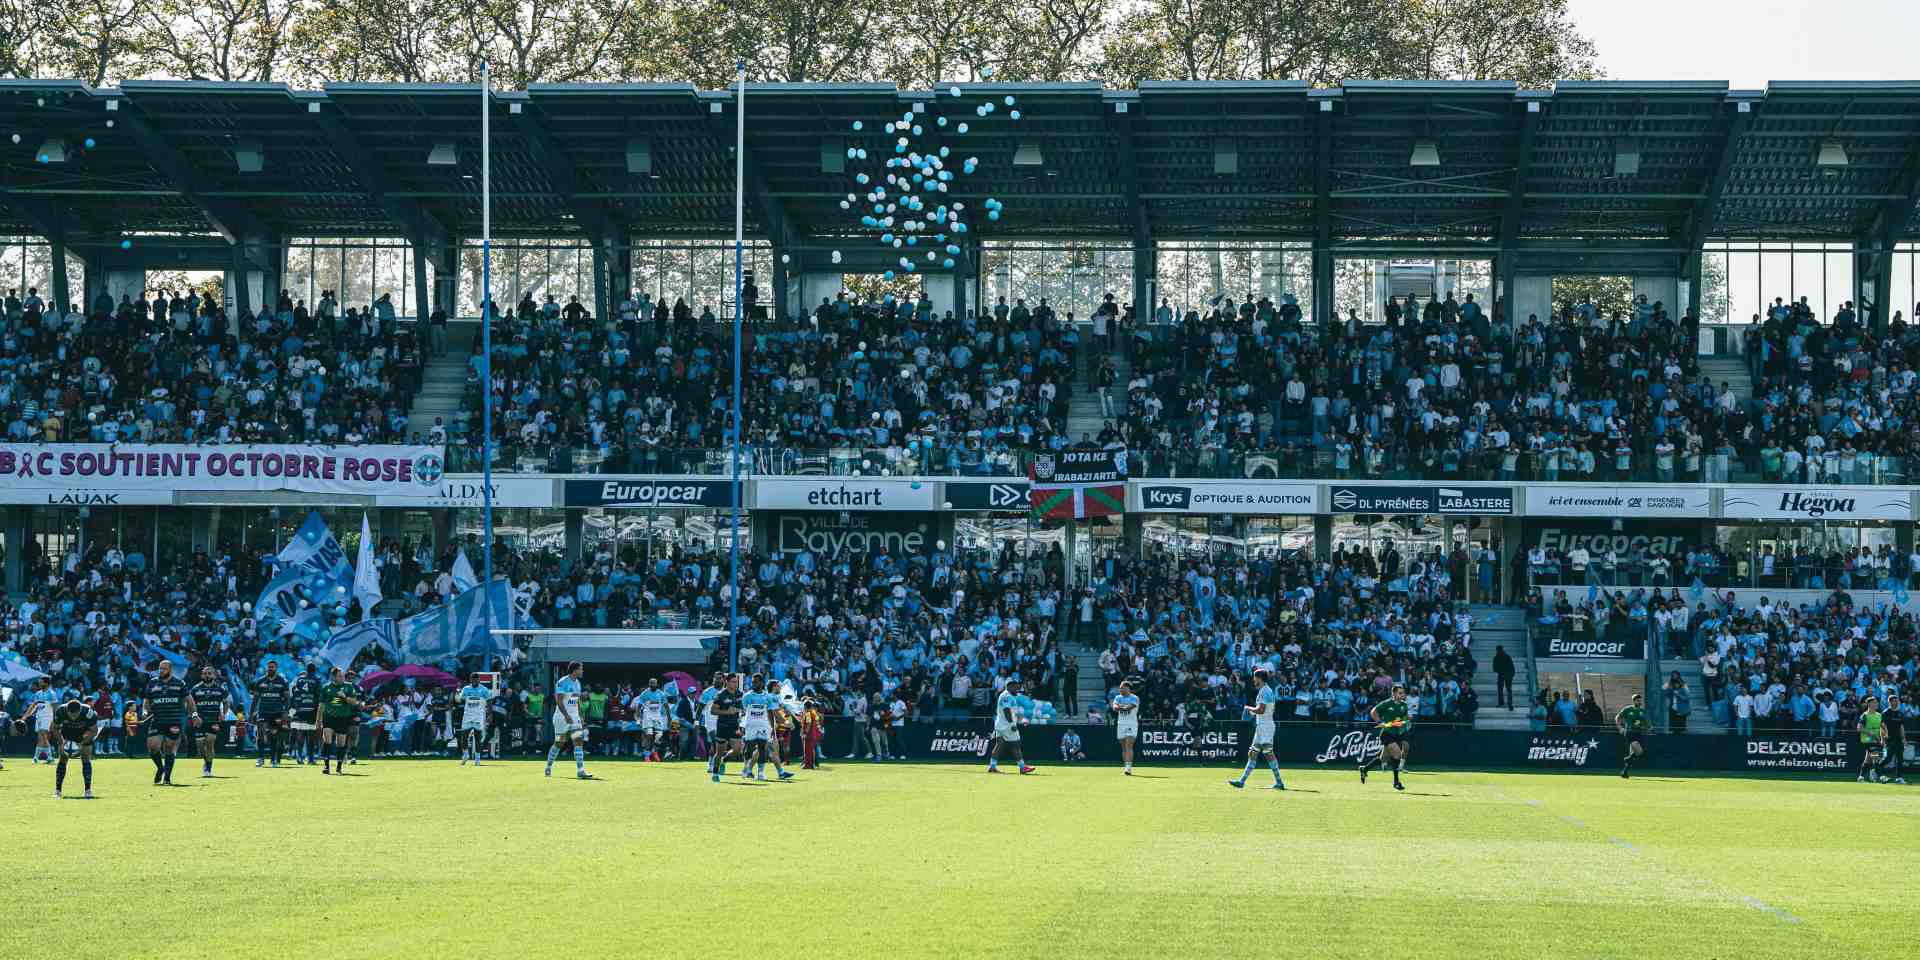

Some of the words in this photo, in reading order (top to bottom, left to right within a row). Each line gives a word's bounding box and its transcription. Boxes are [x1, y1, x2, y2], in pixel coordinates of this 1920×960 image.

[59, 452, 201, 476] SOUTIENT
[206, 453, 336, 479] OCTOBRE
[343, 457, 413, 482] ROSE
[1054, 472, 1092, 481] IRABAZI
[1093, 471, 1117, 480] ARTE
[441, 484, 500, 499] LDAY
[601, 482, 707, 506] Europcar
[808, 486, 882, 506] etchart
[1150, 490, 1183, 505] Krys
[1194, 494, 1244, 504] OPTIQUE
[1257, 495, 1312, 504] AUDITION
[1359, 499, 1373, 509] DL
[1375, 496, 1430, 510] PYRÉNÉES
[1438, 498, 1511, 508] LABASTERE
[1563, 497, 1573, 505] et
[1574, 496, 1624, 506] ensemble
[1779, 492, 1856, 517] Hegoa
[1538, 528, 1684, 558] Europcar
[1550, 639, 1625, 657] Europcar
[931, 734, 989, 757] mendy
[1747, 741, 1847, 756] DELZONGLE
[1528, 744, 1588, 765] mendy
[1747, 758, 1847, 769] www.delzongle.fr
